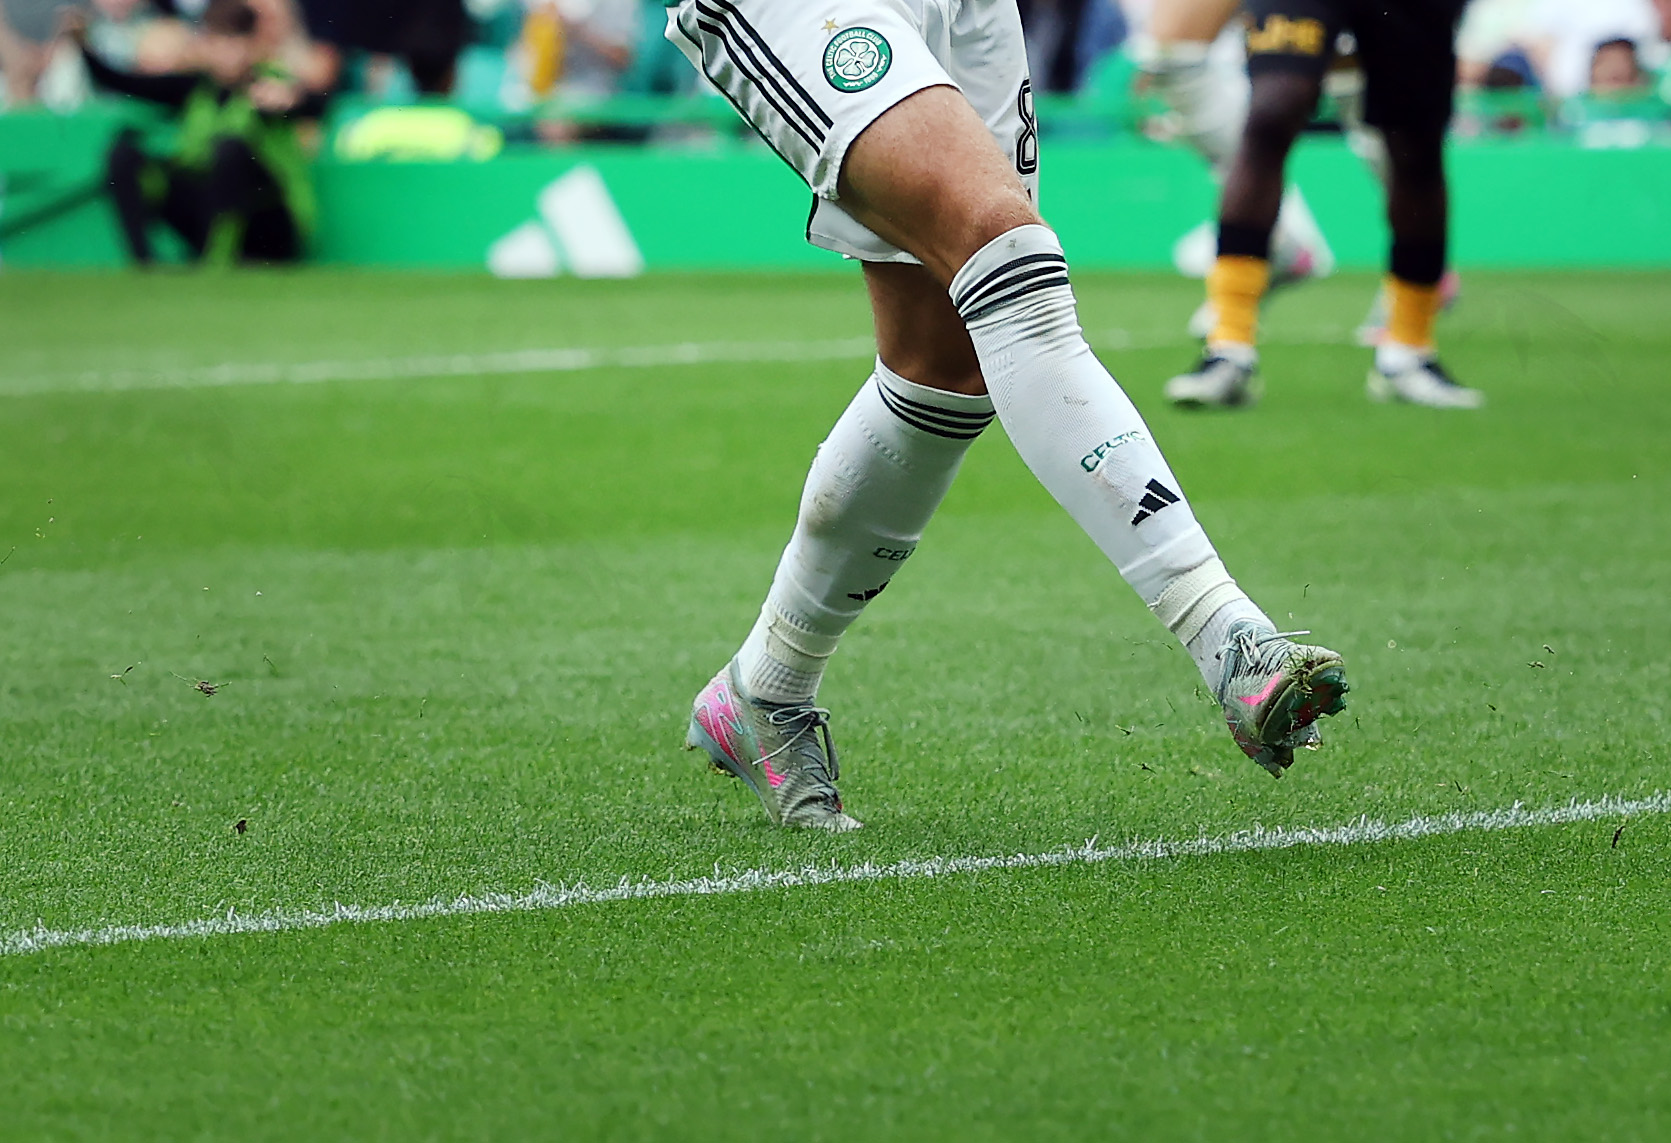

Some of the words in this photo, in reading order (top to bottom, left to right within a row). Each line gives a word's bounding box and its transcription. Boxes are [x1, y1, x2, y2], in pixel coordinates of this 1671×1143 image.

[833, 30, 866, 46] FOOTBALL
[866, 32, 883, 46] CLUB
[1016, 78, 1038, 176] 8
[1080, 430, 1146, 473] CELTIC
